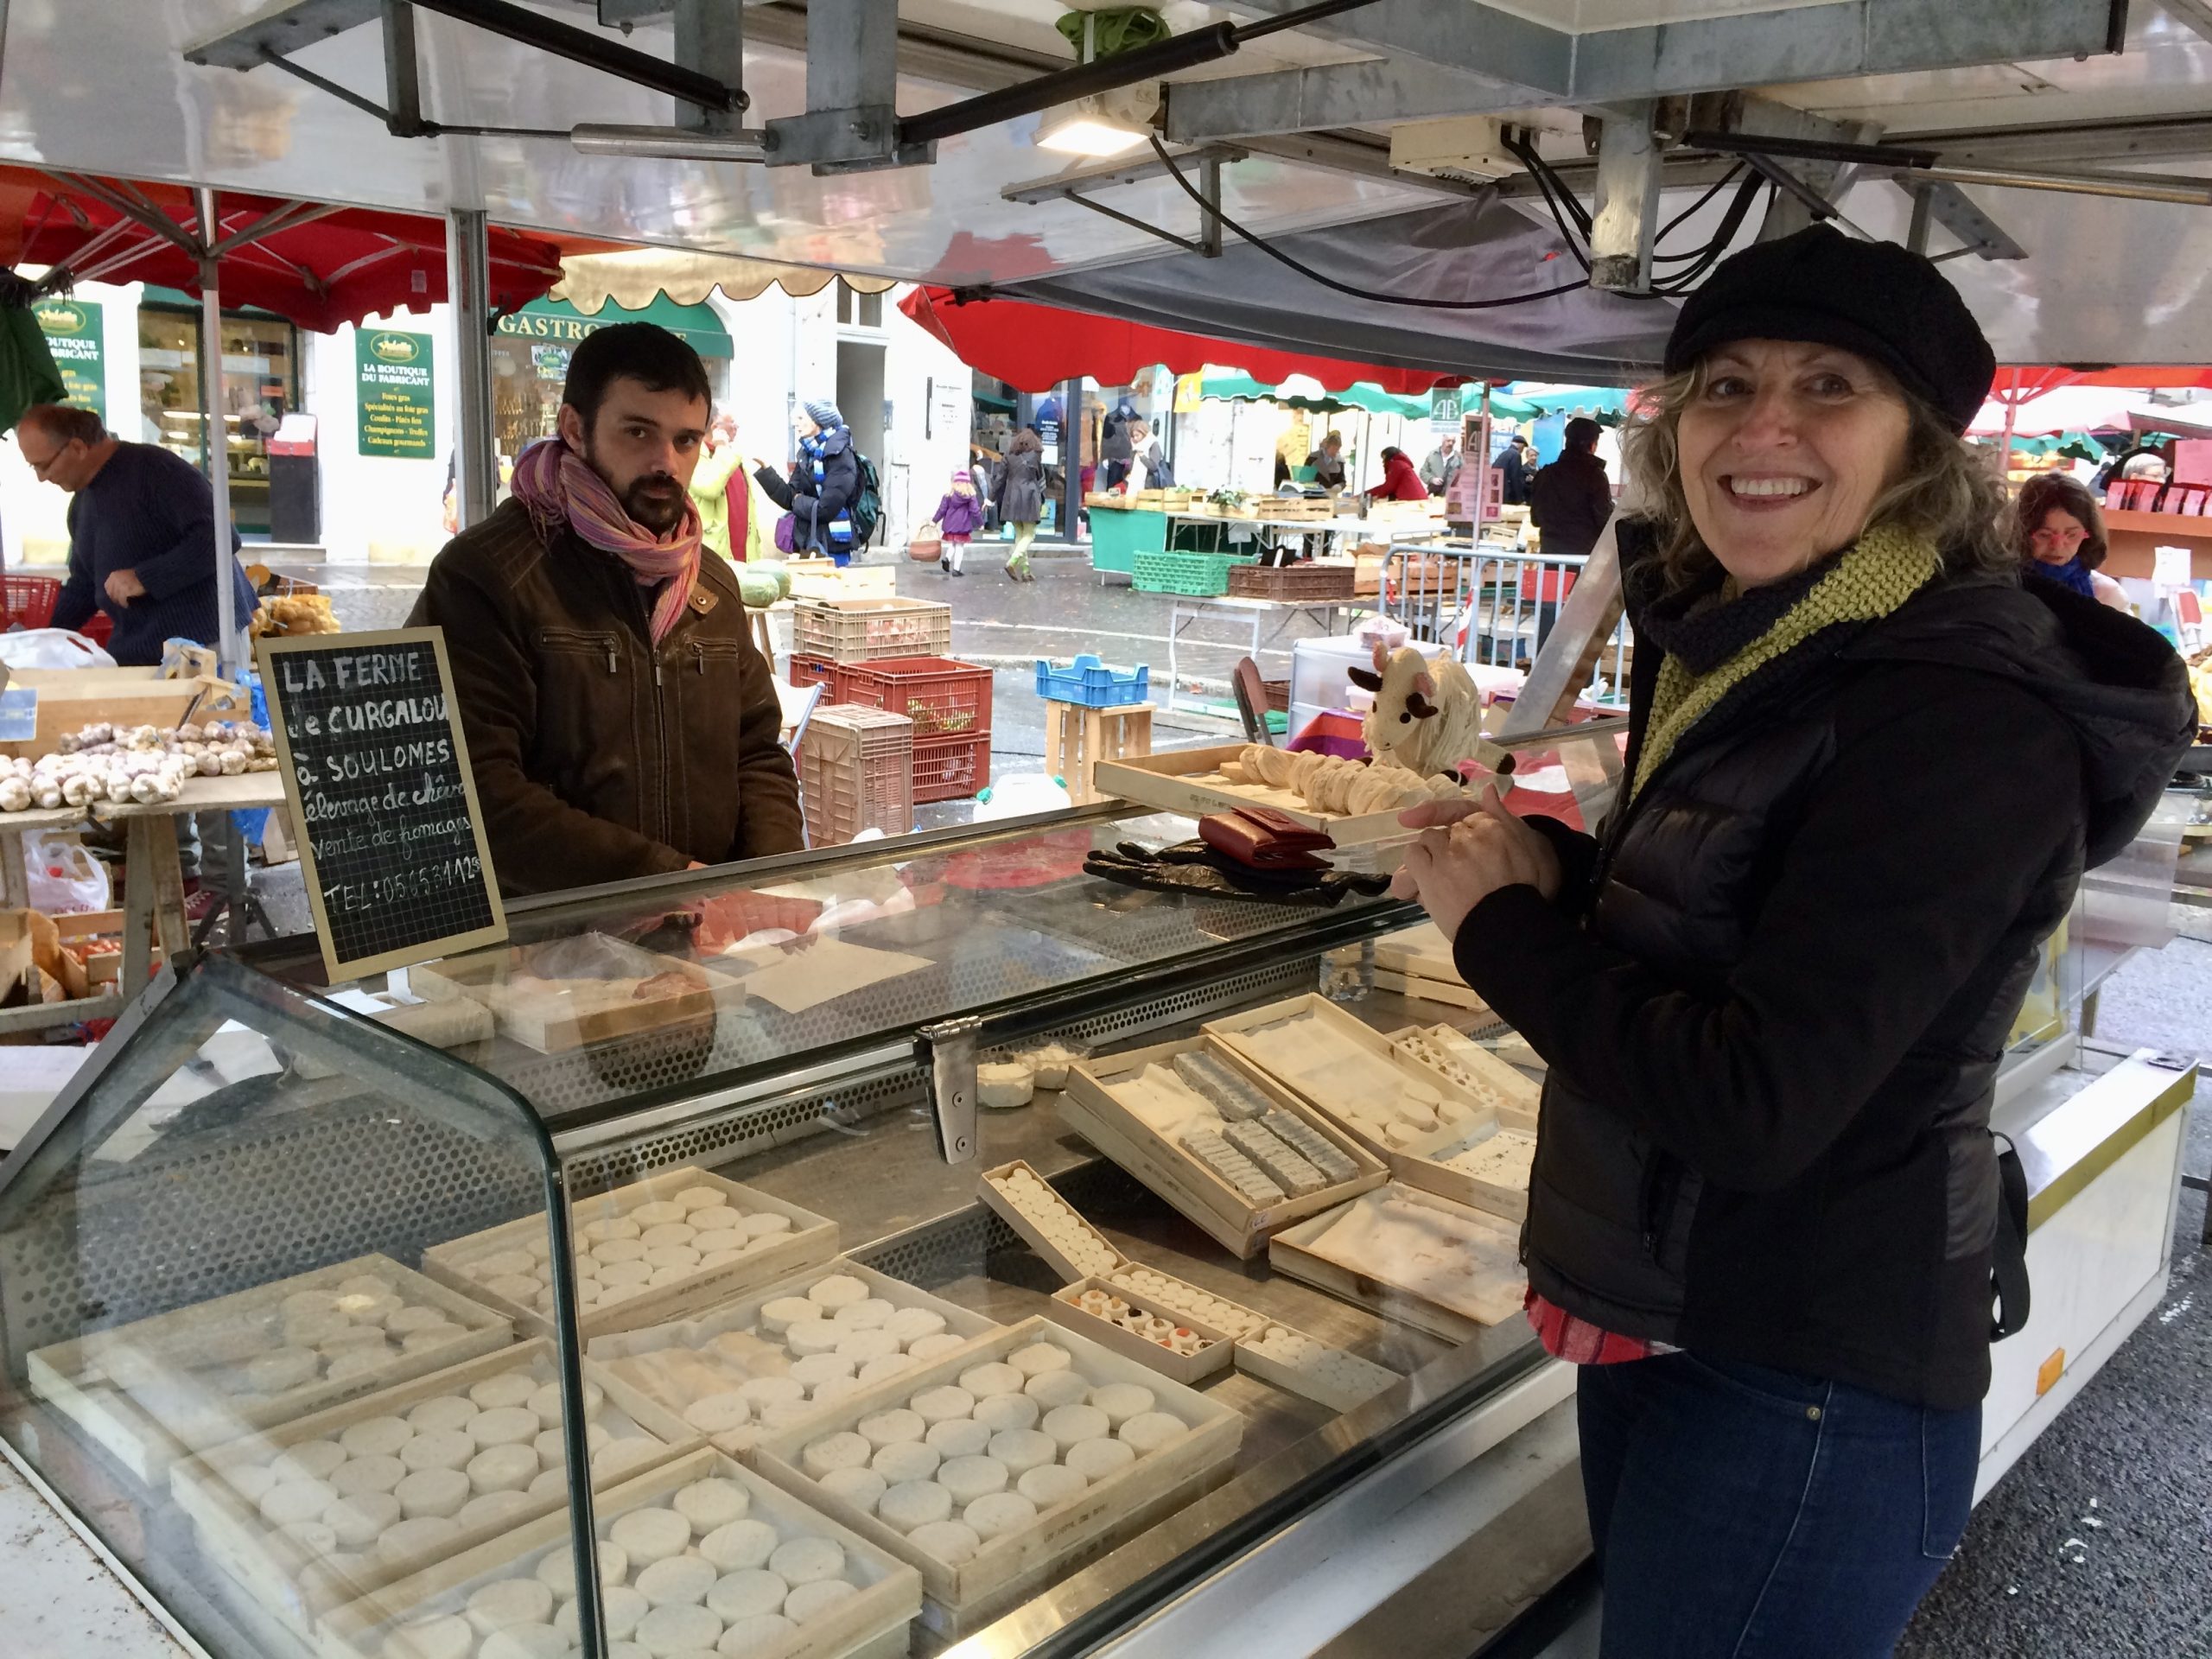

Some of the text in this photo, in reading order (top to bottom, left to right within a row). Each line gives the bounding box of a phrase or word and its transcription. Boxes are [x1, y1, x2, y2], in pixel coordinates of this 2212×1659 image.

[45, 337, 96, 350] OUTIQUE
[362, 373, 430, 386] DU FABRICANT
[364, 364, 428, 377] LA BOUTIQUE
[1433, 399, 1459, 420] AB
[283, 652, 422, 692] LA FERME
[328, 693, 450, 734] CURGALOU
[293, 739, 450, 785] à SOULOMES
[383, 782, 410, 810] de
[372, 822, 396, 847] de
